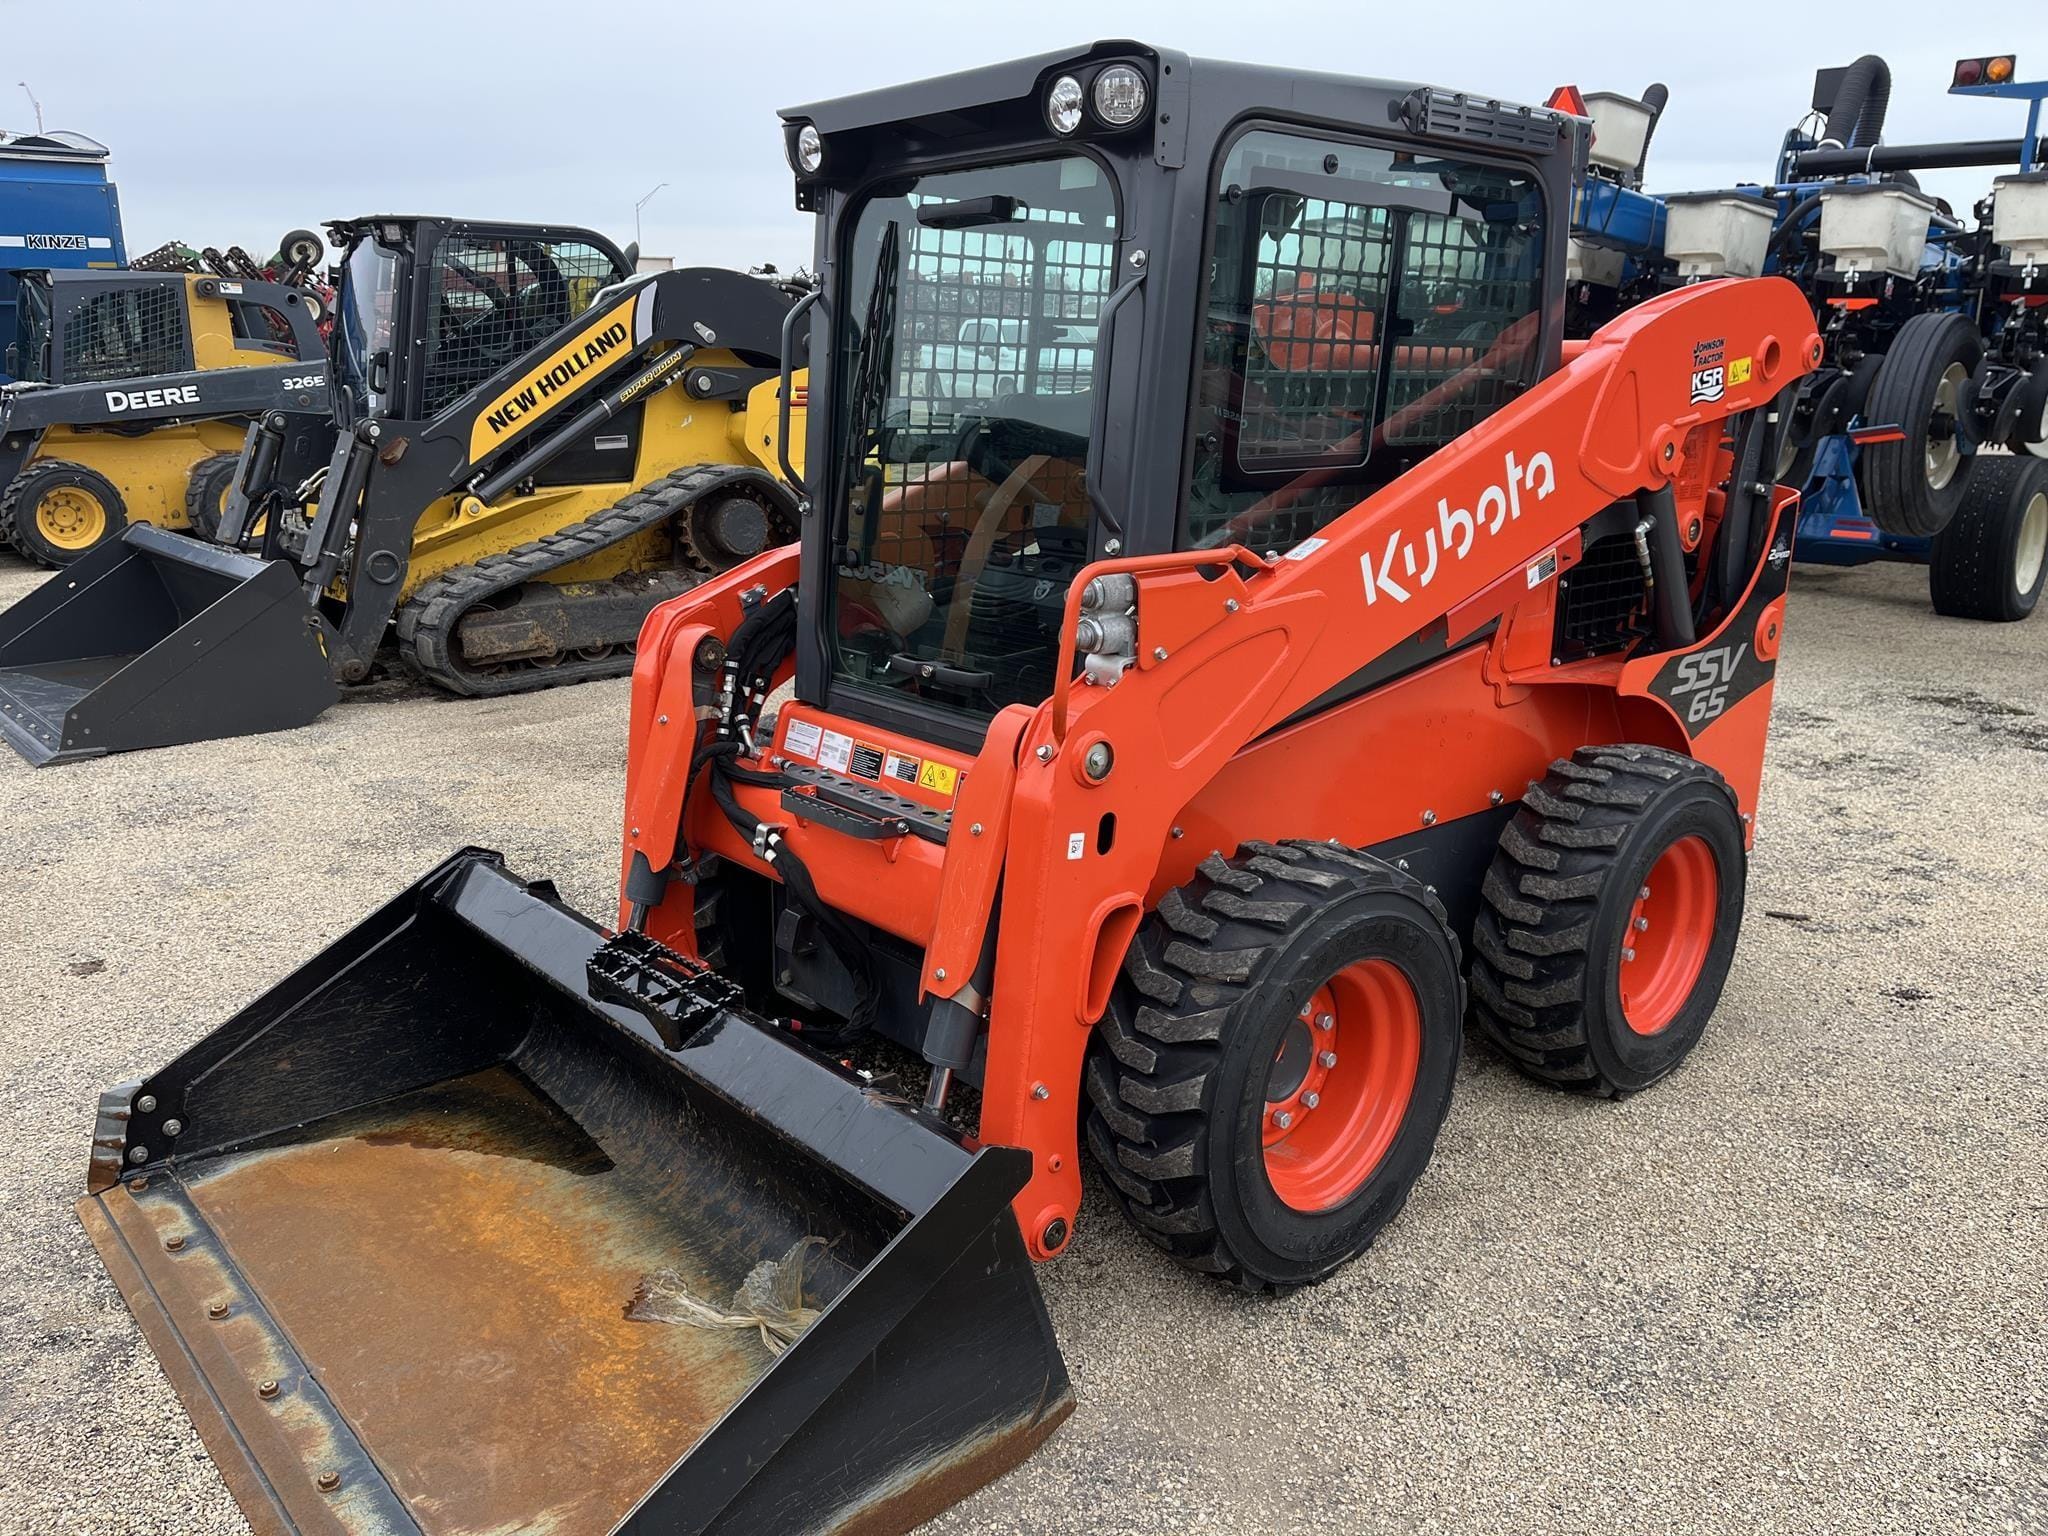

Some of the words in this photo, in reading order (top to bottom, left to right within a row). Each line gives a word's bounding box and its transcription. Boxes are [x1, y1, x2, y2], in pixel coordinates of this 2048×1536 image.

[27, 234, 87, 250] KINZE
[1693, 338, 1725, 355] JOHNSON
[1693, 351, 1724, 367] TRACTOR
[282, 375, 325, 390] 326E
[487, 391, 537, 434] NEW
[535, 322, 627, 398] HOLLAND
[620, 373, 653, 403] SUPER
[652, 351, 682, 379] BOOM
[1691, 366, 1724, 392] KSR
[105, 384, 200, 413] DEERE
[1360, 450, 1555, 606] Kubota
[1670, 642, 1748, 696] SSV
[1687, 684, 1729, 723] 65
